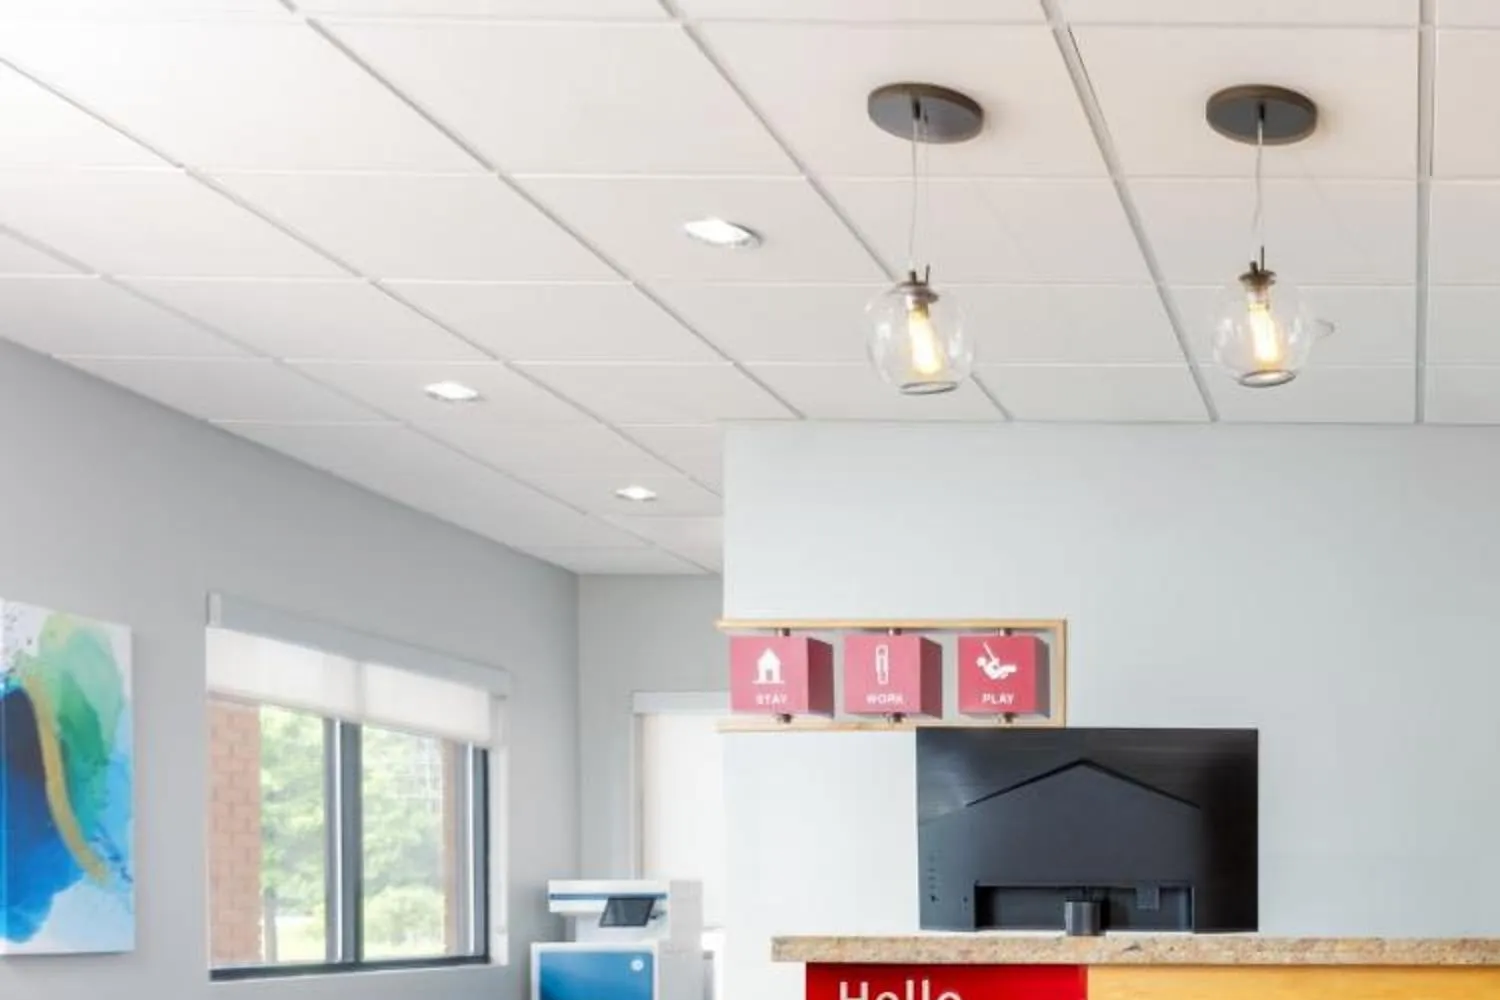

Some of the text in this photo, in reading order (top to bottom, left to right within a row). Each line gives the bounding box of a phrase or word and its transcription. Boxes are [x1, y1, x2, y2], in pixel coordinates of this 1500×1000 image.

[755, 693, 788, 705] STAY
[866, 693, 904, 705] WORK
[981, 693, 1015, 705] PLAY
